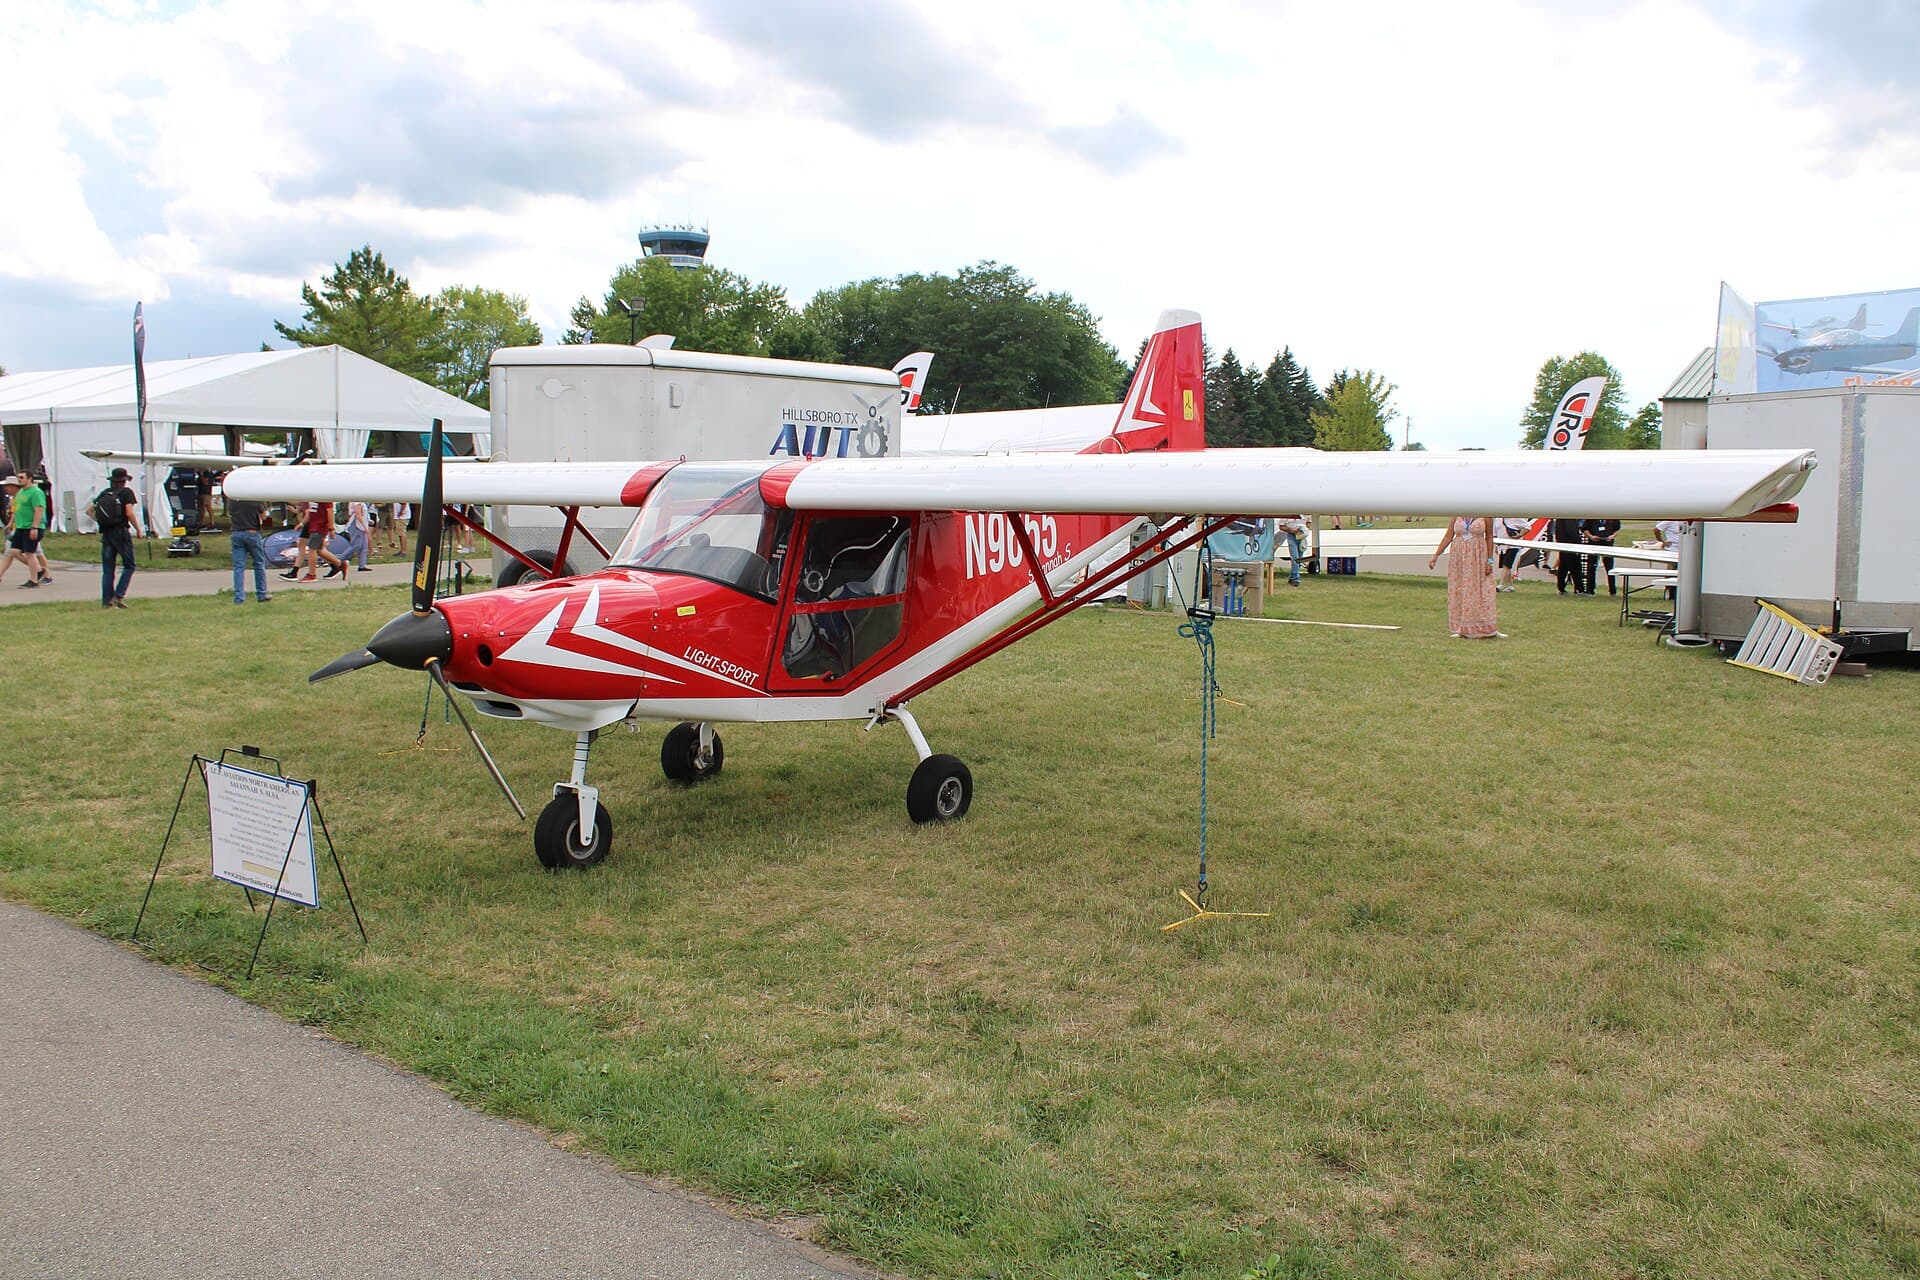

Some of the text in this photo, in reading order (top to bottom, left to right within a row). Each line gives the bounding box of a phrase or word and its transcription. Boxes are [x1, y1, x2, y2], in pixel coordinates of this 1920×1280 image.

[782, 407, 858, 424] HILLSBORO, TX
[683, 646, 760, 685] LIGHT-SPORT
